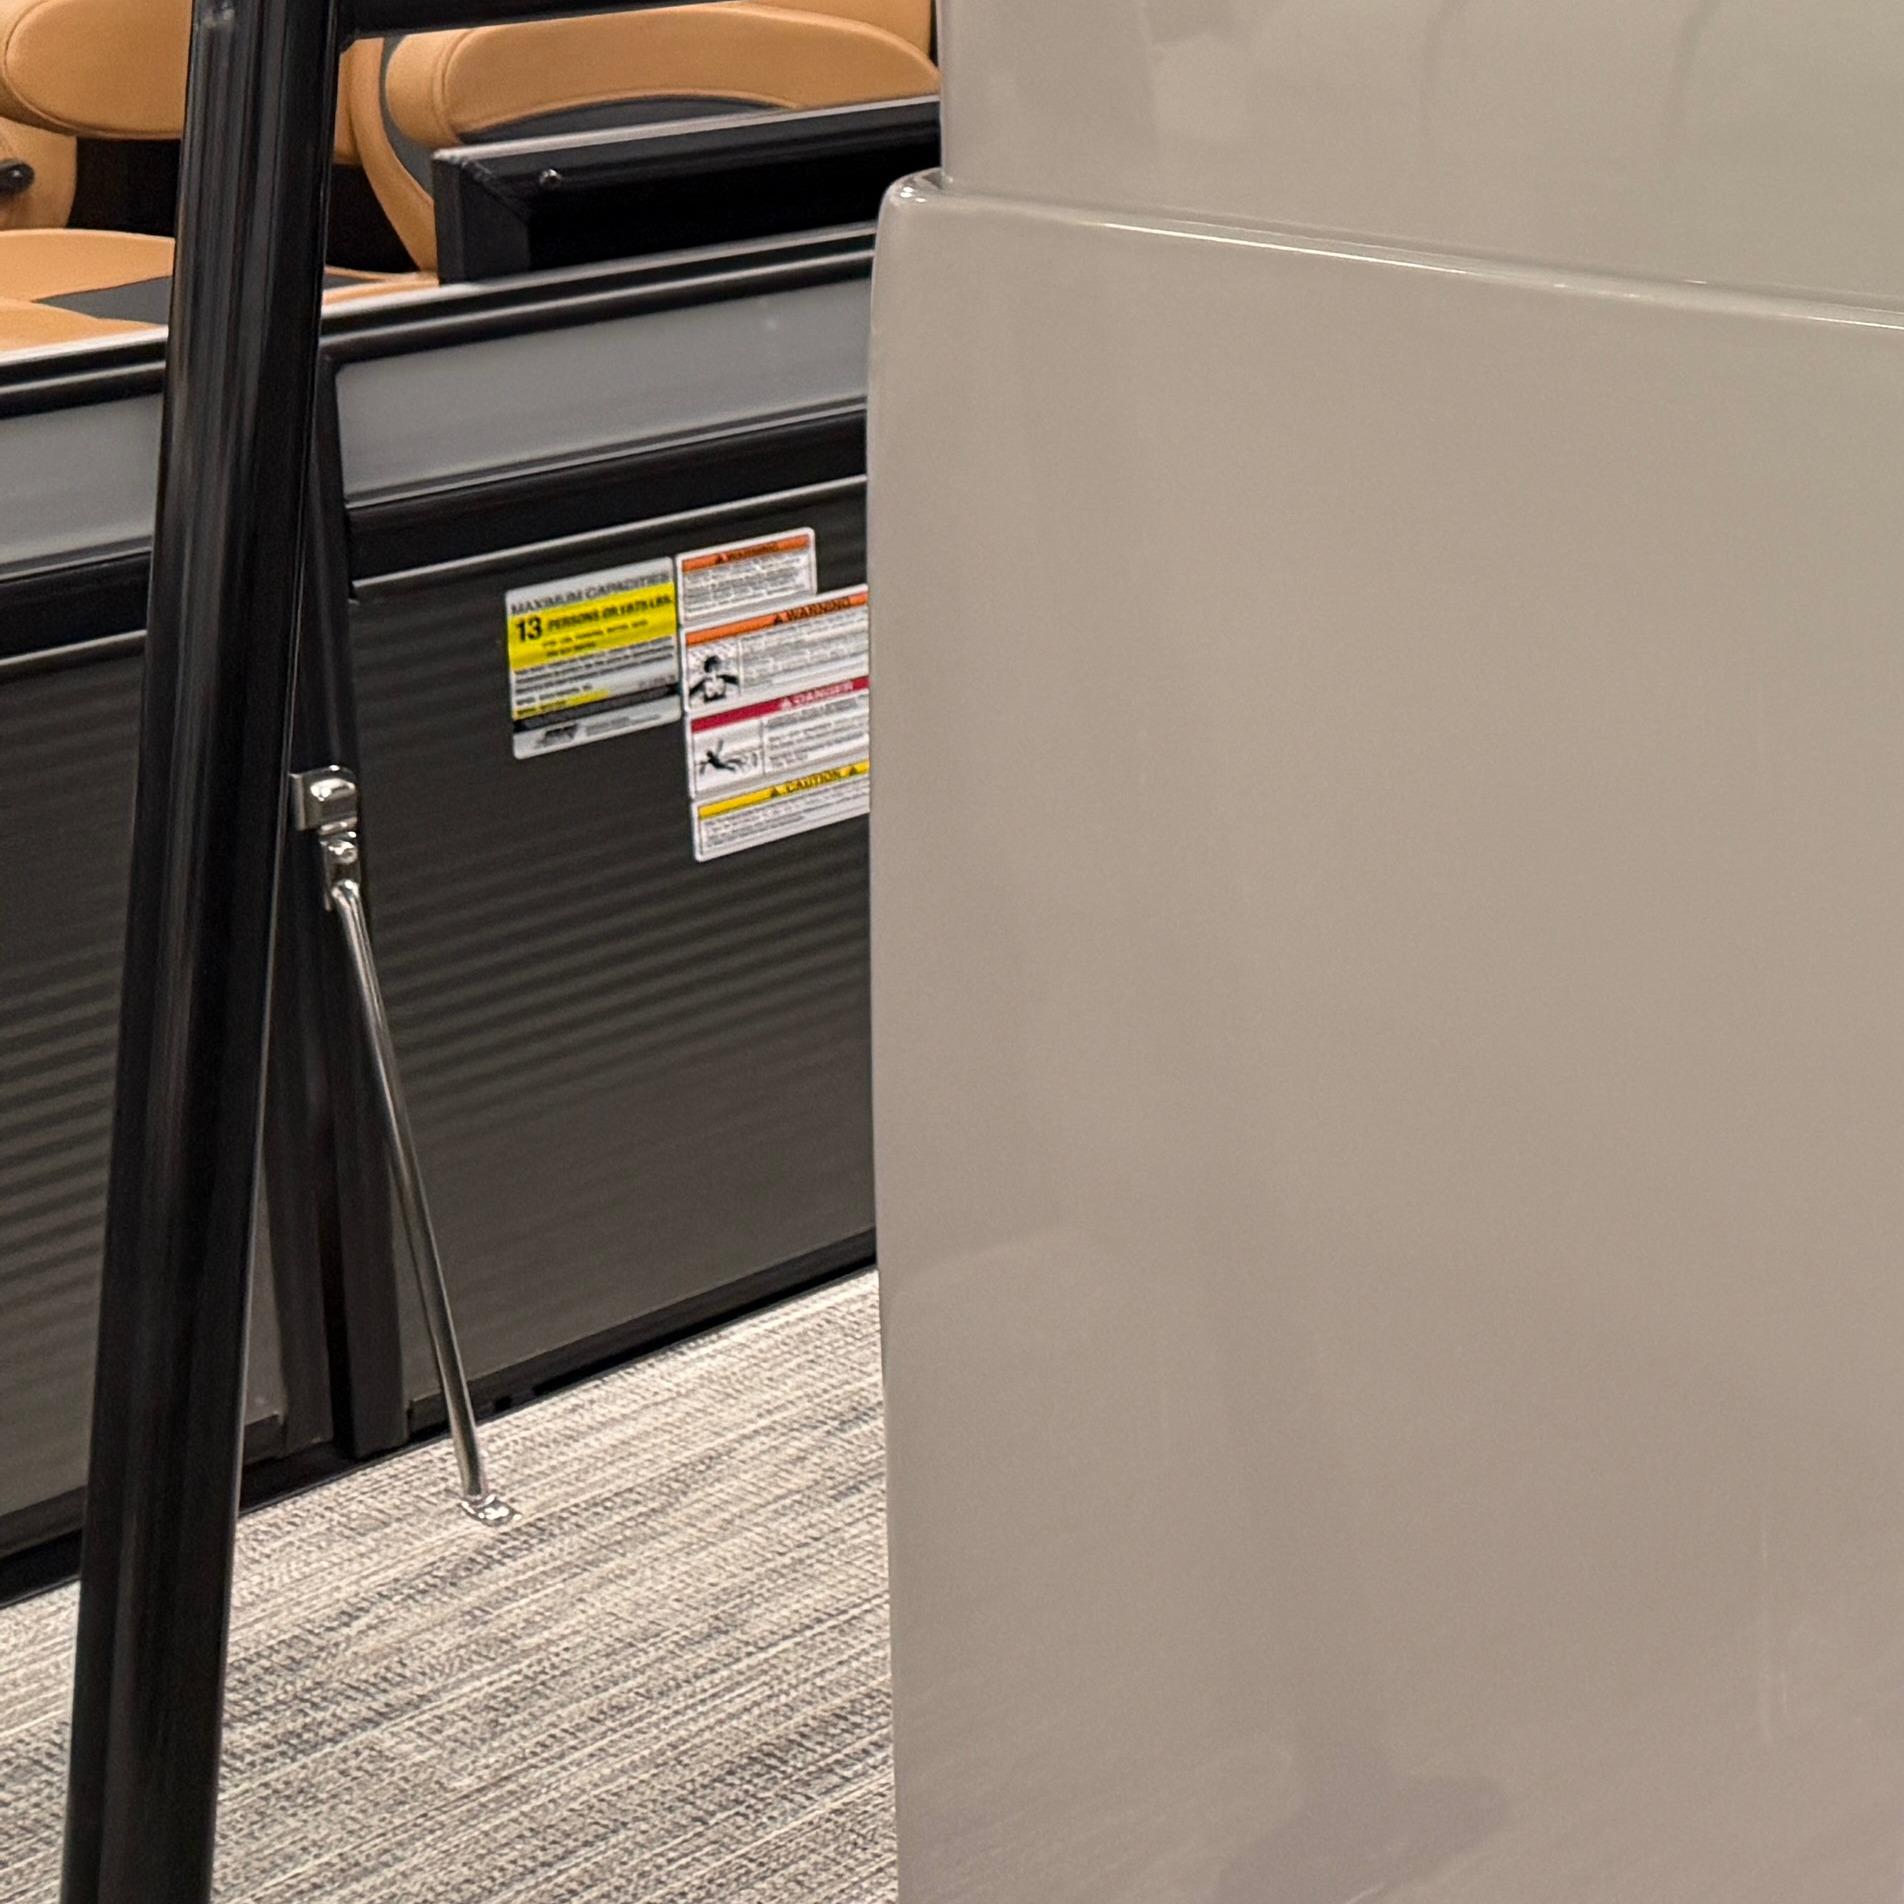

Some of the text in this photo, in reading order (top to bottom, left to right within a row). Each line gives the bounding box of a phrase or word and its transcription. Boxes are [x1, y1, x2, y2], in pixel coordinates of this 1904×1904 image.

[786, 597, 851, 617] WARNING
[516, 616, 543, 642] 13
[786, 770, 841, 793] CAUTION
